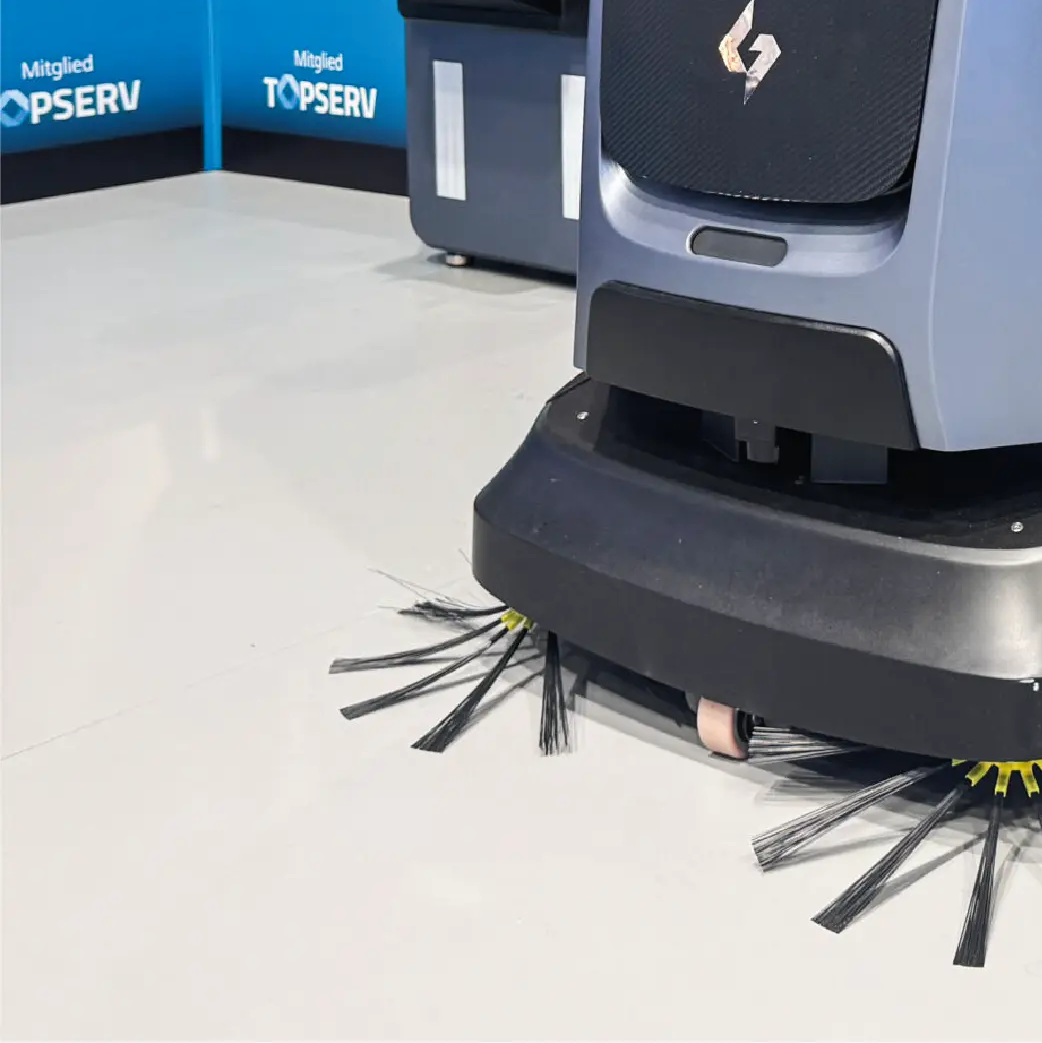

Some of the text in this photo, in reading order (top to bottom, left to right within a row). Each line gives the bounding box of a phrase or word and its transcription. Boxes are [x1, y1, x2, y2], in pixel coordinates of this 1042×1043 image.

[22, 53, 94, 81] Mitglied
[293, 49, 343, 74] Mitglied
[263, 73, 378, 119] TOPSERV
